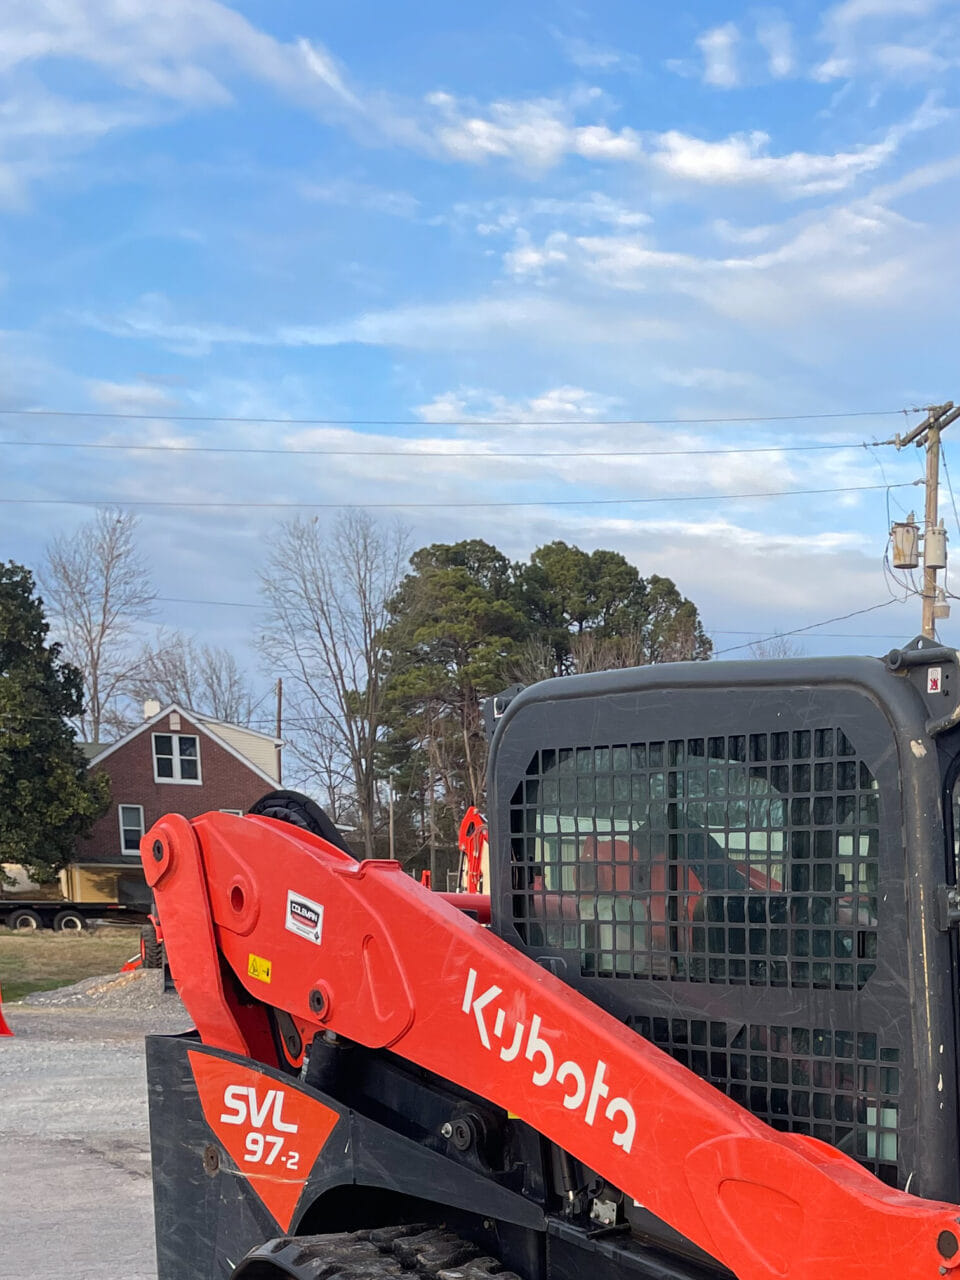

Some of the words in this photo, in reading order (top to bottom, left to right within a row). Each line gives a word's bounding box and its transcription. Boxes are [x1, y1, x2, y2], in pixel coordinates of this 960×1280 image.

[292, 903, 318, 923] COLEMAN
[462, 967, 637, 1154] Kubota
[220, 1085, 298, 1134] SVL
[244, 1131, 300, 1170] 97-2
